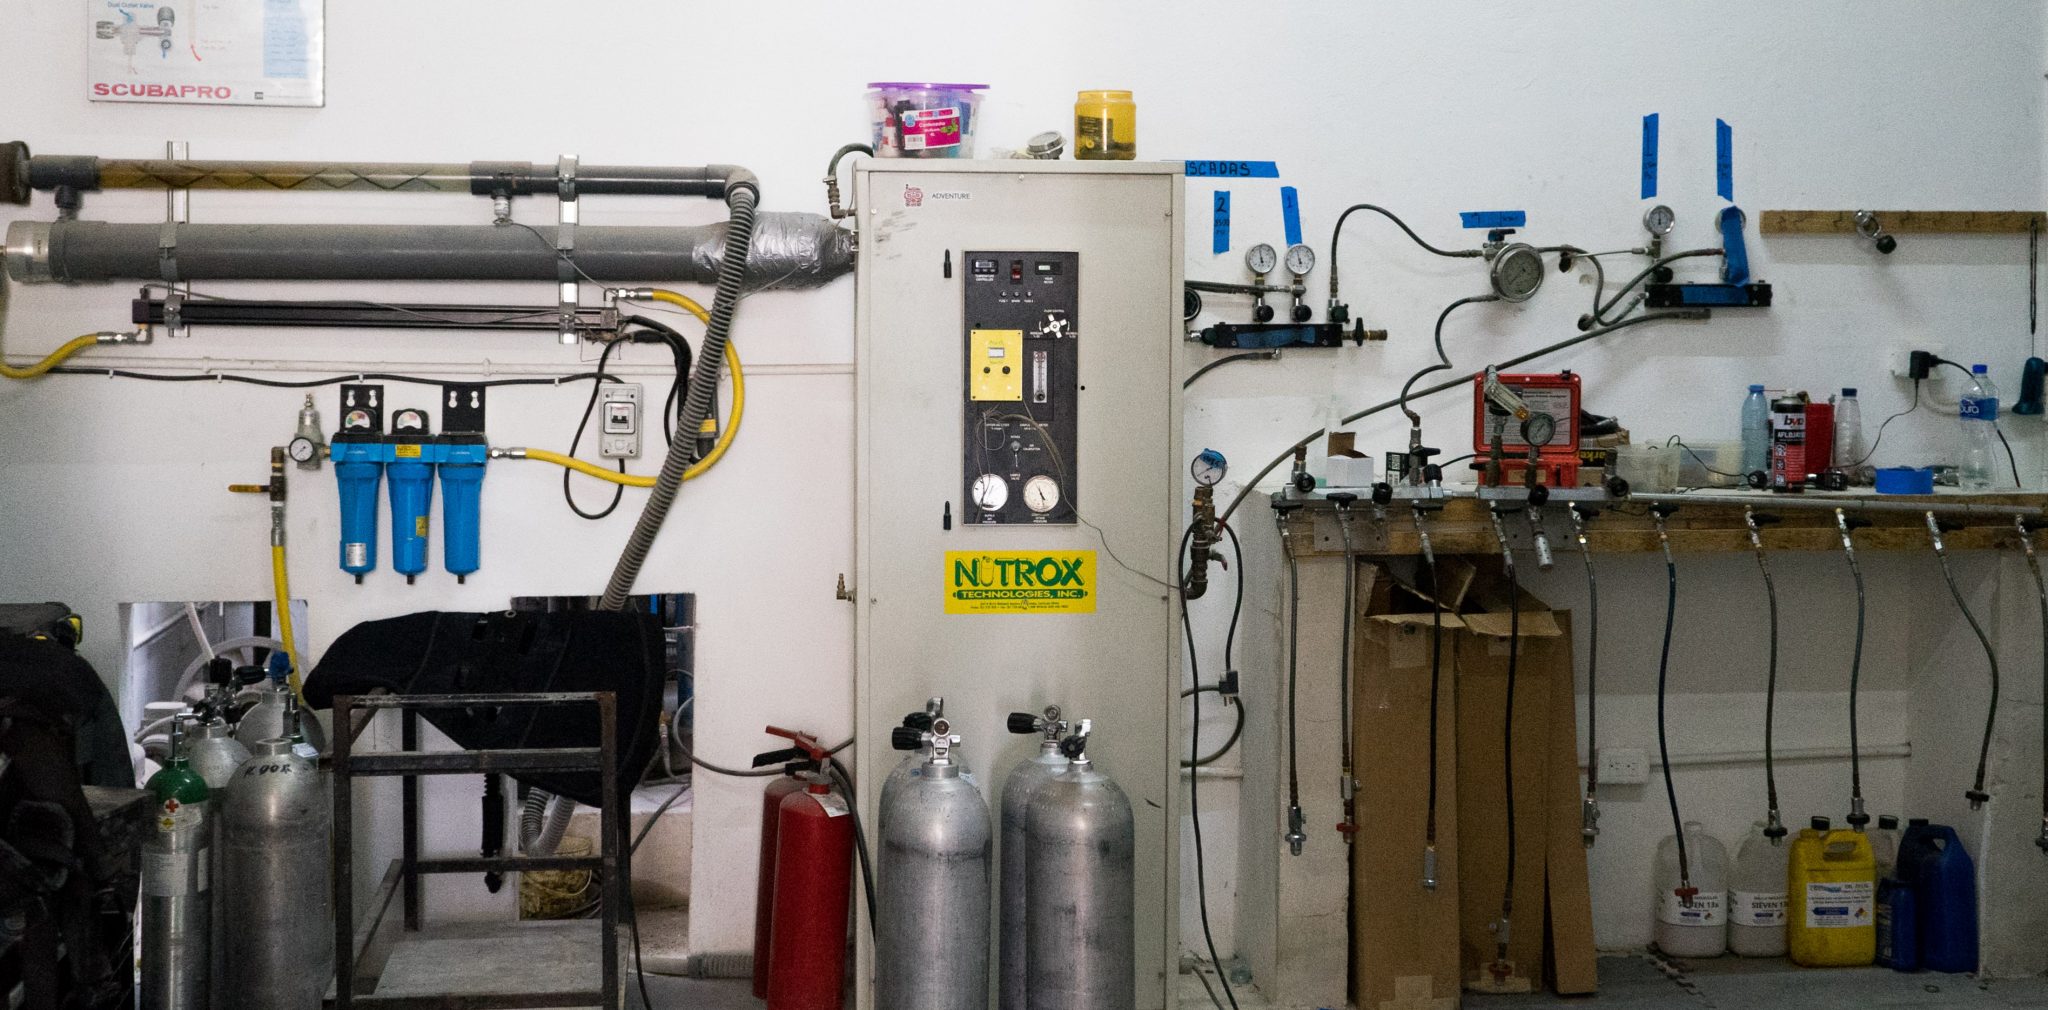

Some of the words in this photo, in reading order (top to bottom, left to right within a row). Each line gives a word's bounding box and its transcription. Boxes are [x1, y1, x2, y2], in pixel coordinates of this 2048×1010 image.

[93, 83, 231, 99] SCUBAPRO
[931, 192, 971, 200] ADVENTURE
[1286, 195, 1293, 209] 1
[1216, 196, 1227, 213] 2
[954, 556, 1085, 587] NITROX
[961, 590, 1054, 599] TECHNOLOGIES,
[1057, 590, 1081, 599] INC.
